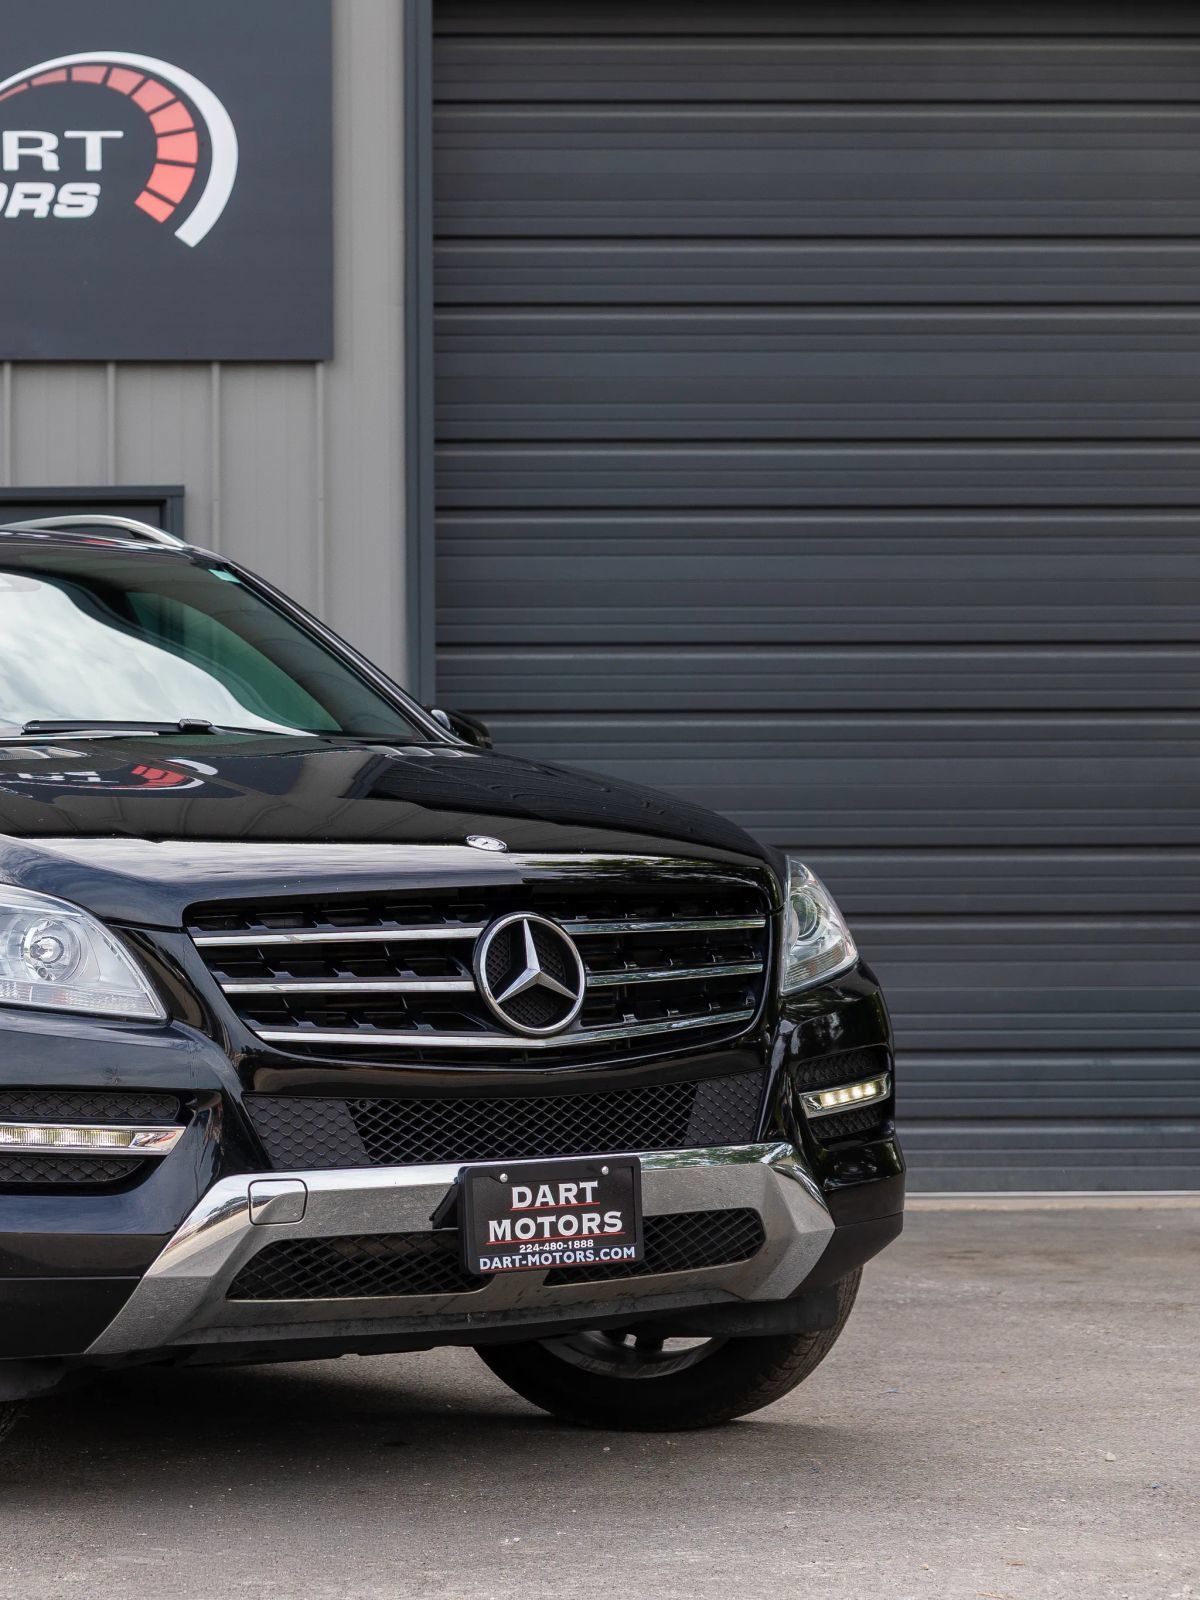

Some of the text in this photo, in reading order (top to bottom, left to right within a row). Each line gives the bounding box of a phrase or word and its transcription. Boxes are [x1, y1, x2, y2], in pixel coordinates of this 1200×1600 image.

[512, 1181, 598, 1208] DART
[488, 1211, 623, 1242] MOTORS
[480, 1246, 636, 1270] DART-MOTORS.COM
[519, 1239, 594, 1253] 224-480-1888
